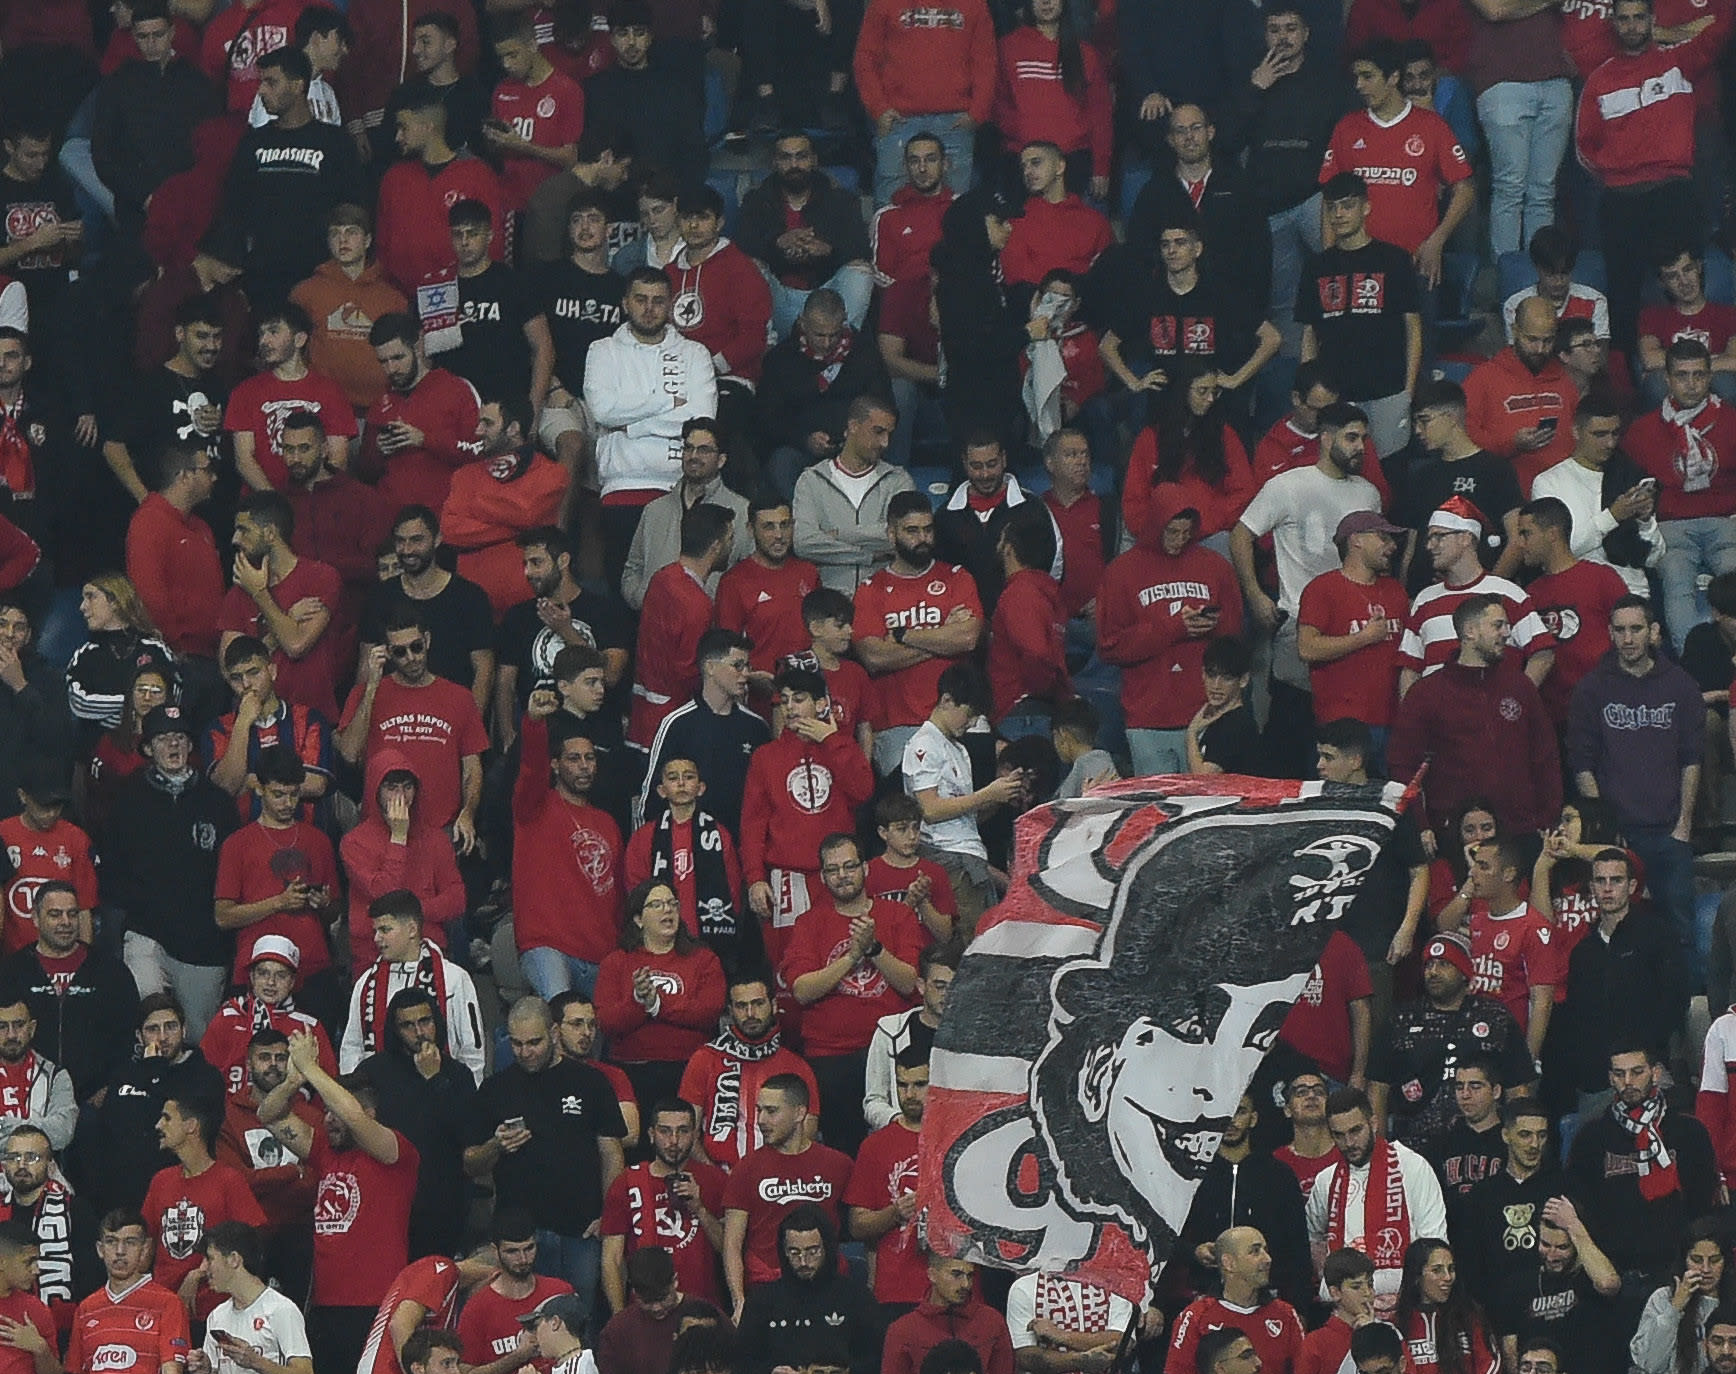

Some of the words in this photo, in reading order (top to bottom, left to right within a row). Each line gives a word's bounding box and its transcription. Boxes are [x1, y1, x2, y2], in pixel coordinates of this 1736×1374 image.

[255, 147, 325, 169] THRASHER
[1139, 581, 1210, 606] WISCONSIN
[379, 714, 415, 732] ULTRAS
[417, 713, 452, 735] HAPOEL
[399, 725, 415, 735] TEL
[758, 1175, 833, 1205] Carlsberg
